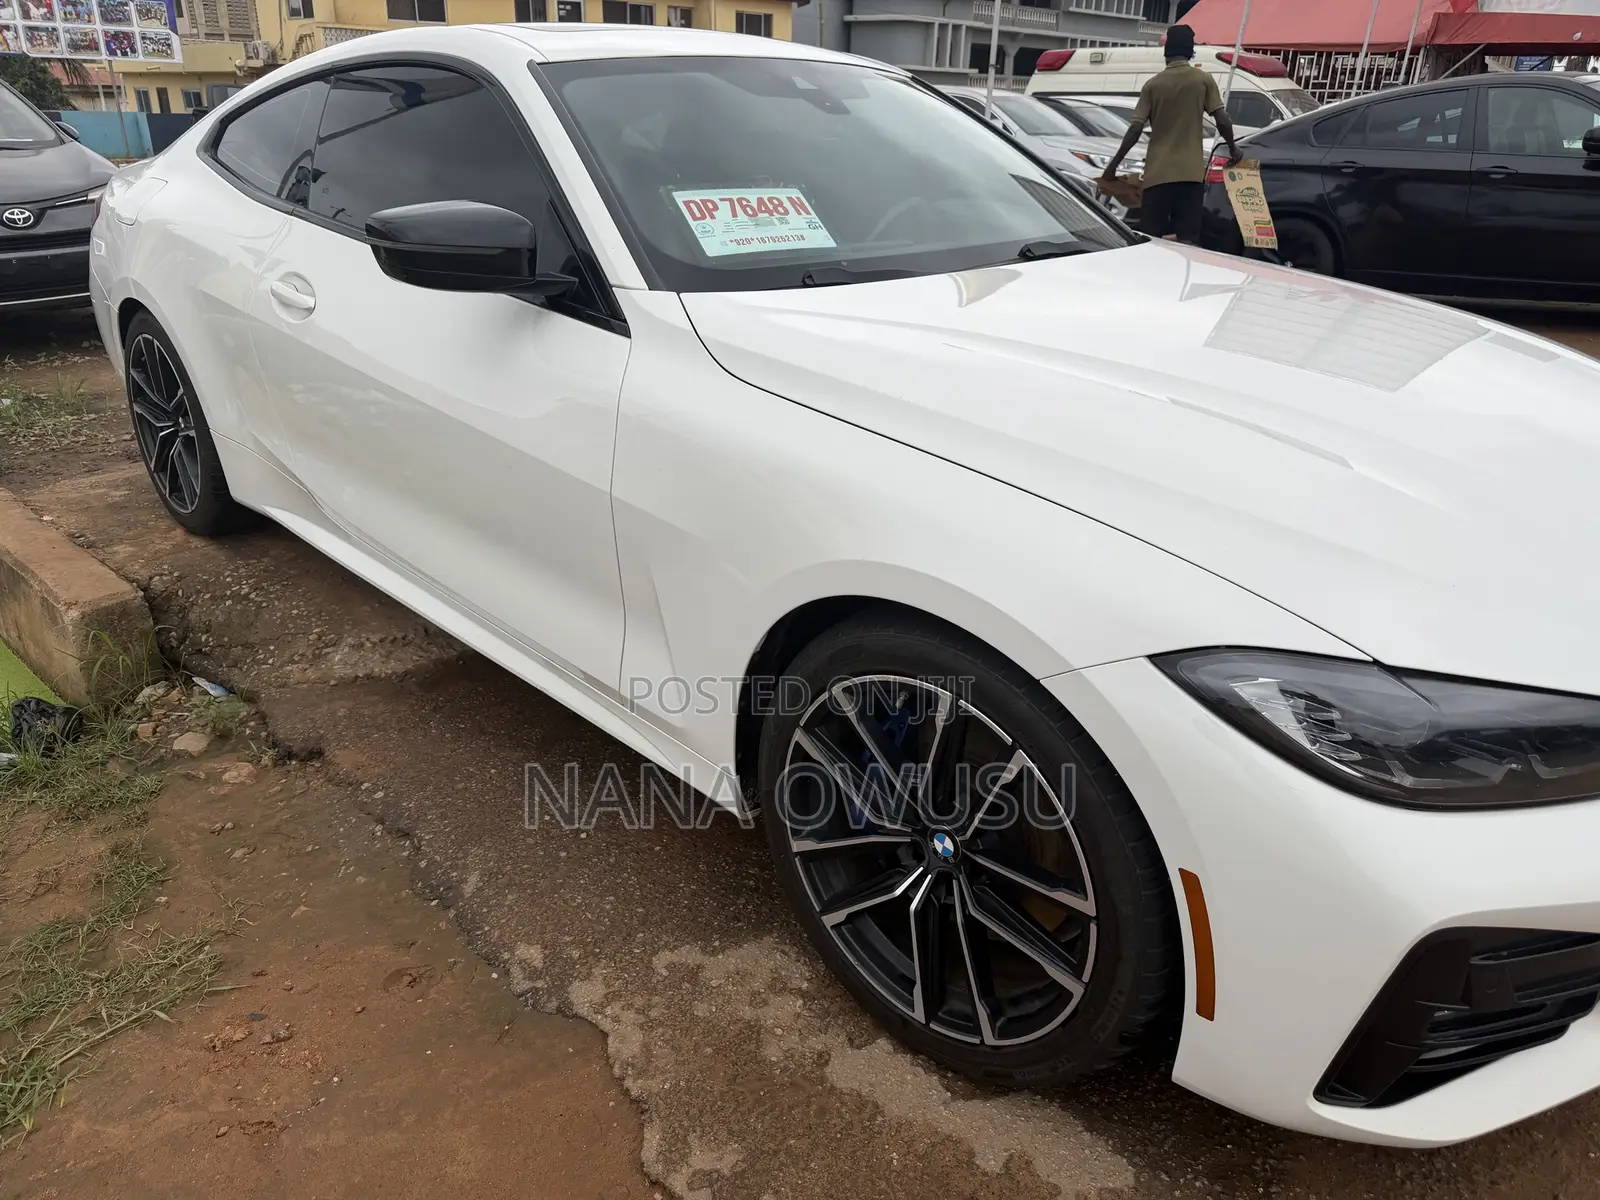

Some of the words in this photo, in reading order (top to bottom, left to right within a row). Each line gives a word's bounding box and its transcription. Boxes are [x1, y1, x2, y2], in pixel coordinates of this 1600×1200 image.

[682, 199, 719, 221] DP
[718, 196, 790, 219] 7648
[785, 196, 812, 216] N
